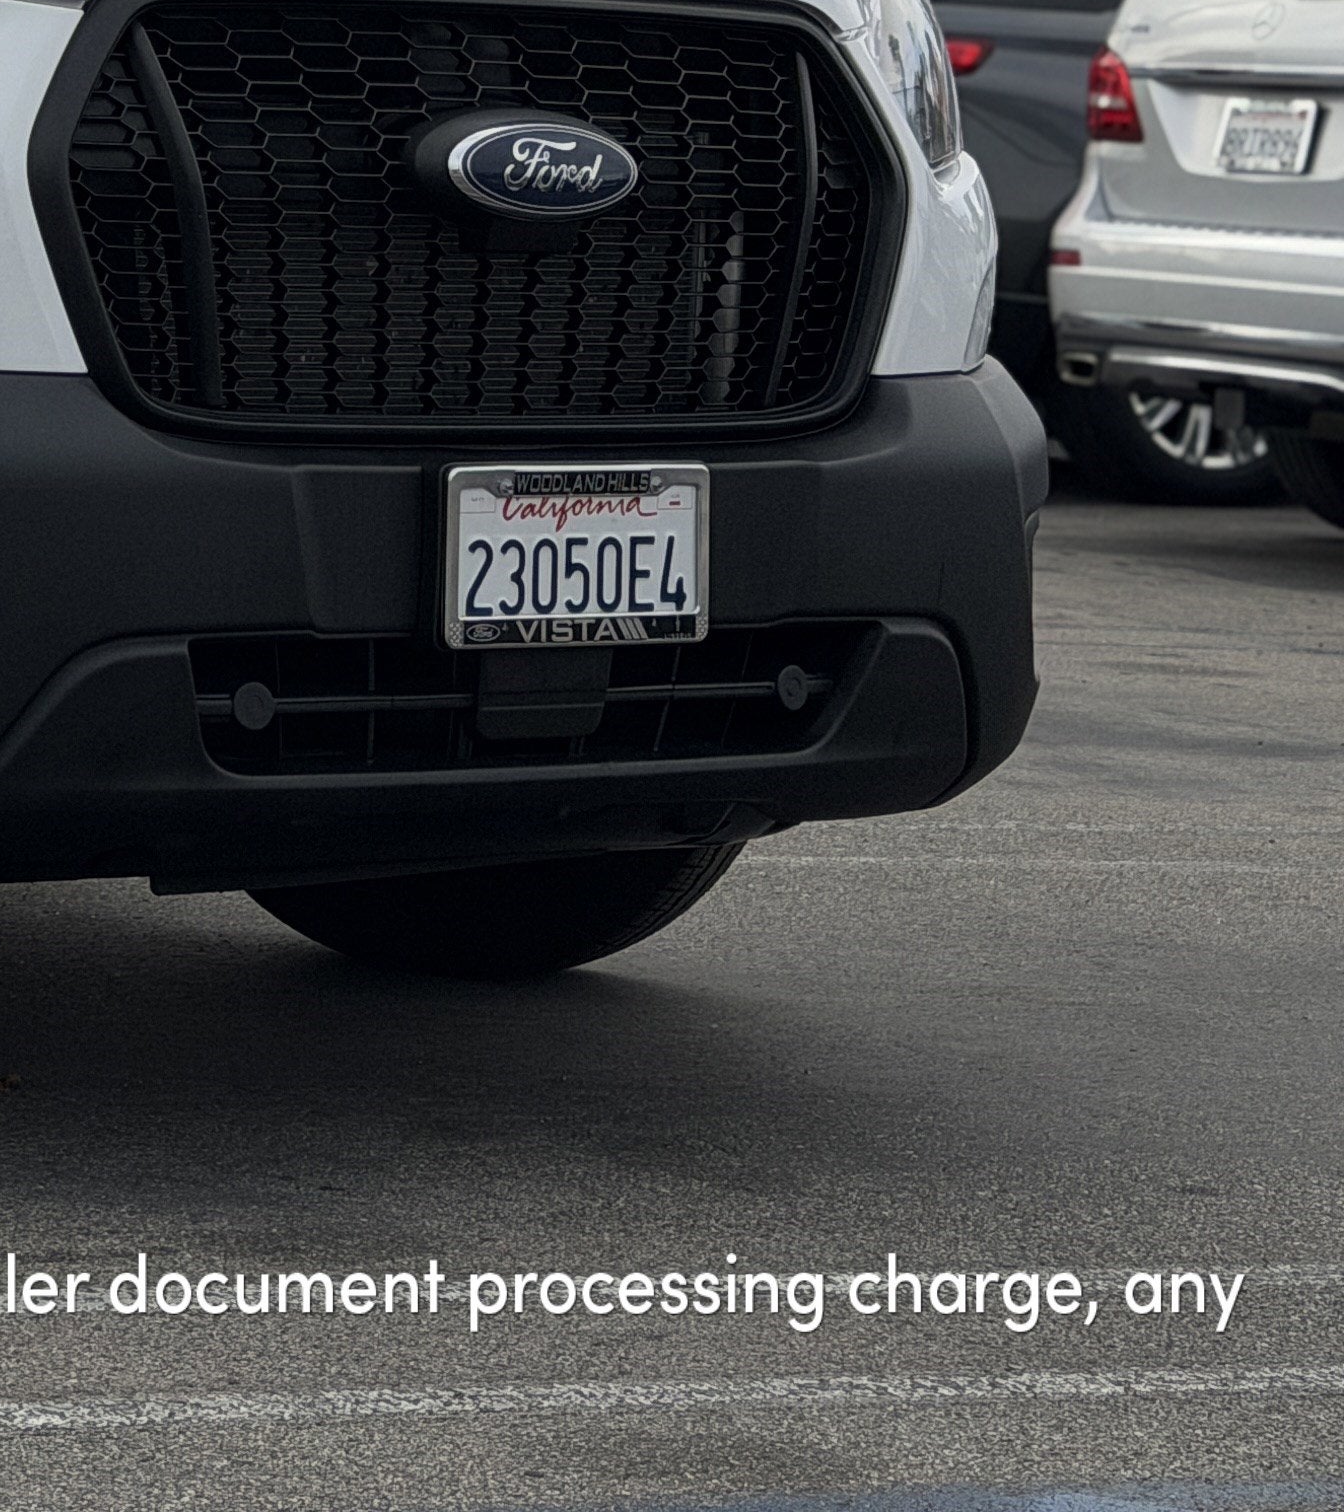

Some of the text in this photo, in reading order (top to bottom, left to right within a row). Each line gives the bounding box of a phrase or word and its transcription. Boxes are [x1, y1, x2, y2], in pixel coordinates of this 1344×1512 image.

[503, 137, 604, 192] Ford
[516, 473, 650, 493] WOODLAND HILLS
[501, 495, 658, 532] California
[465, 535, 687, 616] 23050E4
[515, 618, 622, 643] VISTA
